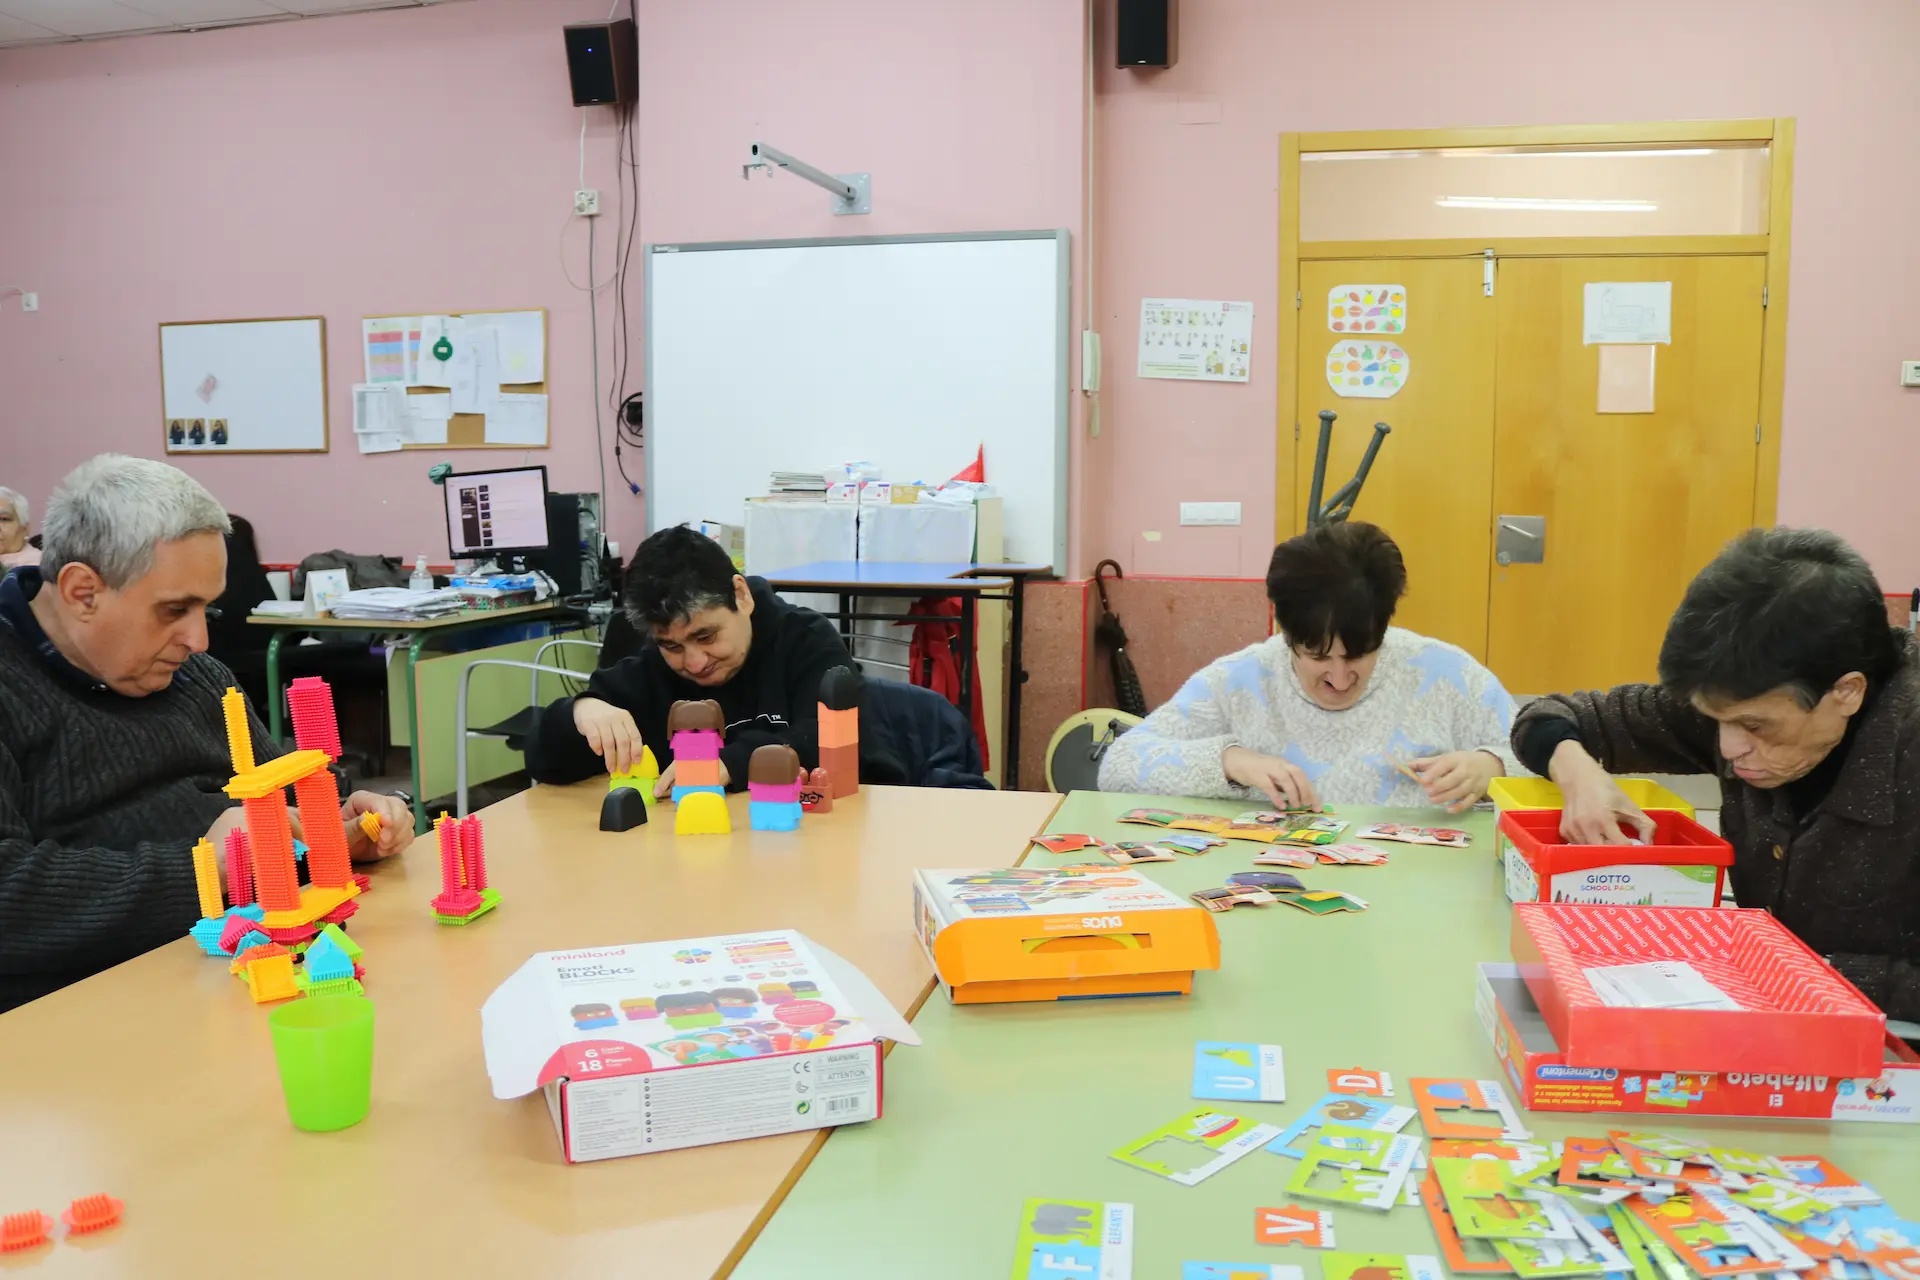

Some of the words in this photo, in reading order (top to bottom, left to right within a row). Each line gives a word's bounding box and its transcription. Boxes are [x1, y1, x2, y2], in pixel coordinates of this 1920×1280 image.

[1586, 874, 1631, 884] GIOTTO
[1580, 884, 1611, 892] SCHOOL
[1614, 884, 1636, 892] PACK
[1081, 915, 1123, 929] DUOS
[1592, 909, 1623, 941] Clementoni
[1617, 916, 1648, 948] Clementoni
[1686, 915, 1718, 947] Clementoni
[1643, 925, 1674, 957] Clementoni
[551, 948, 626, 961] miniland
[557, 964, 603, 973] Emoti
[559, 967, 635, 980] BLOCKS
[584, 1048, 599, 1058] 6
[827, 1053, 860, 1063] WARNING
[577, 1060, 603, 1072] 18
[1541, 1067, 1601, 1079] Clementoni
[828, 1070, 866, 1080] ATTENTION
[1336, 1074, 1378, 1089] D
[1727, 1072, 1830, 1092] Alfabeto
[1213, 1075, 1256, 1090] U
[1768, 1093, 1784, 1108] El
[1108, 1208, 1123, 1245] ELEFANTE
[1264, 1213, 1316, 1235] V
[1042, 1253, 1094, 1272] F
